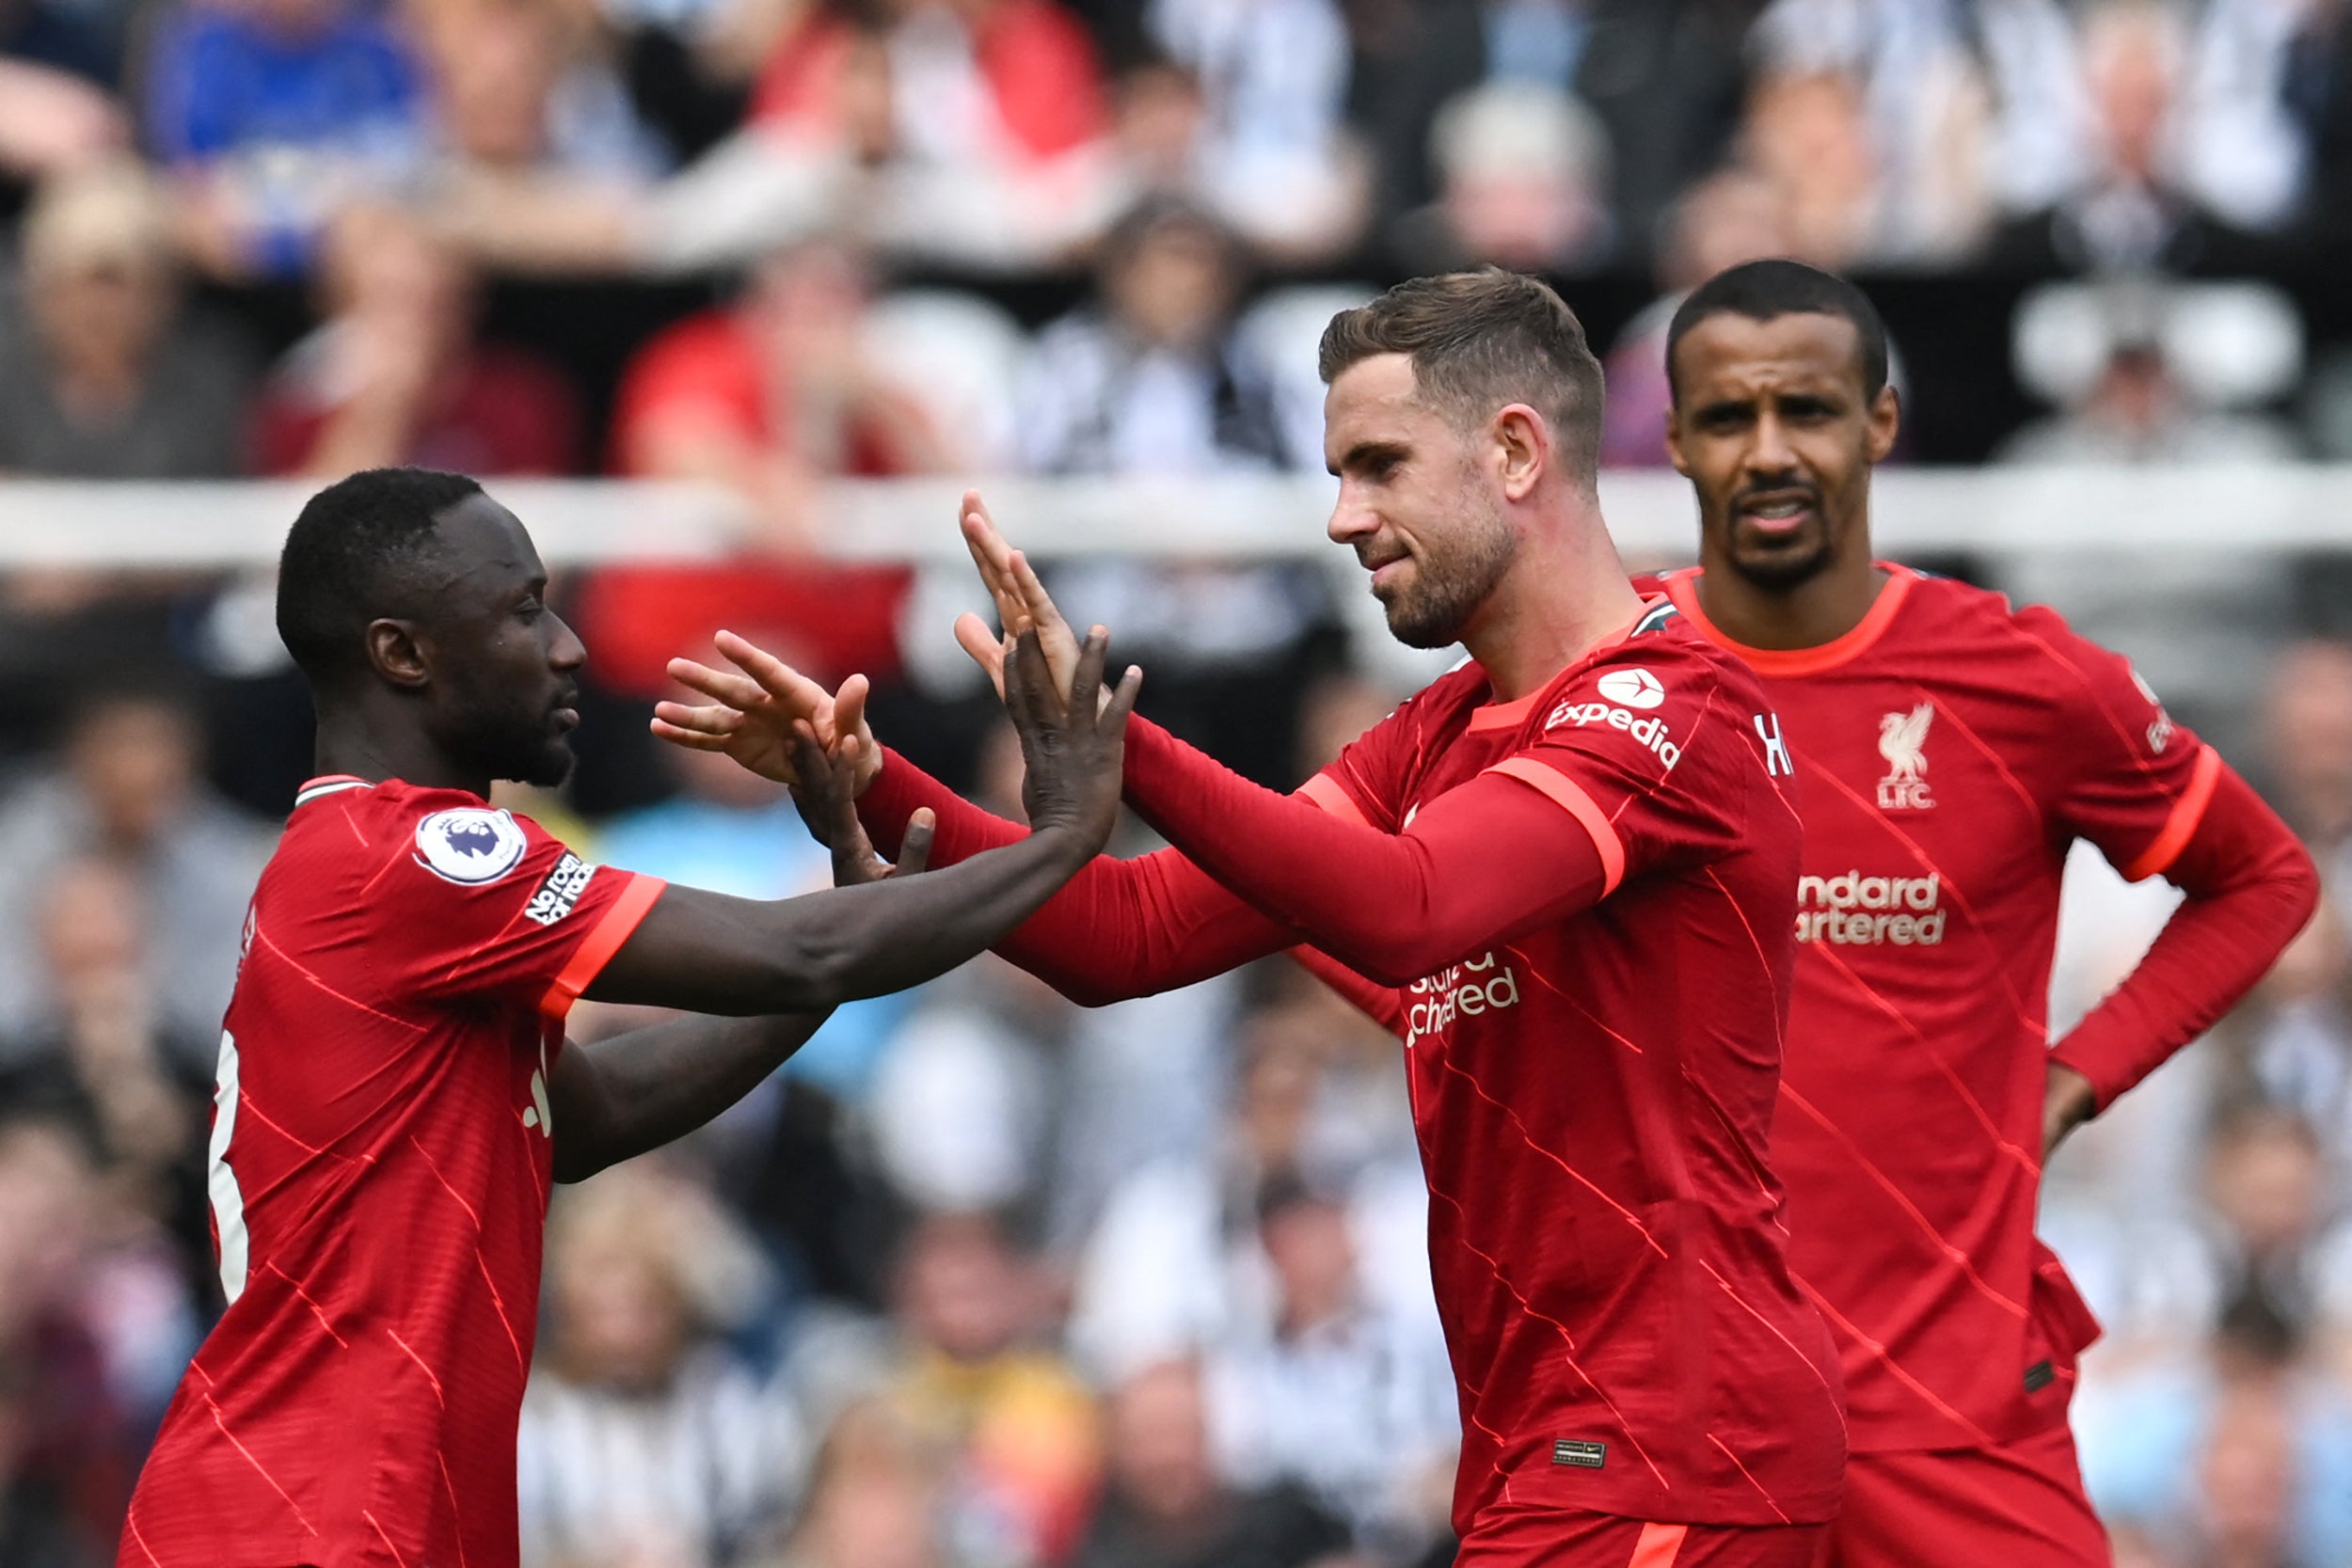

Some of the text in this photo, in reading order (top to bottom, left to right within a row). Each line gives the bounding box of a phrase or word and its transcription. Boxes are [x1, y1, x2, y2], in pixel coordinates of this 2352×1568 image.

[1545, 702, 1680, 770] Expedia
[1754, 712, 1794, 777] H
[525, 890, 557, 924] No
